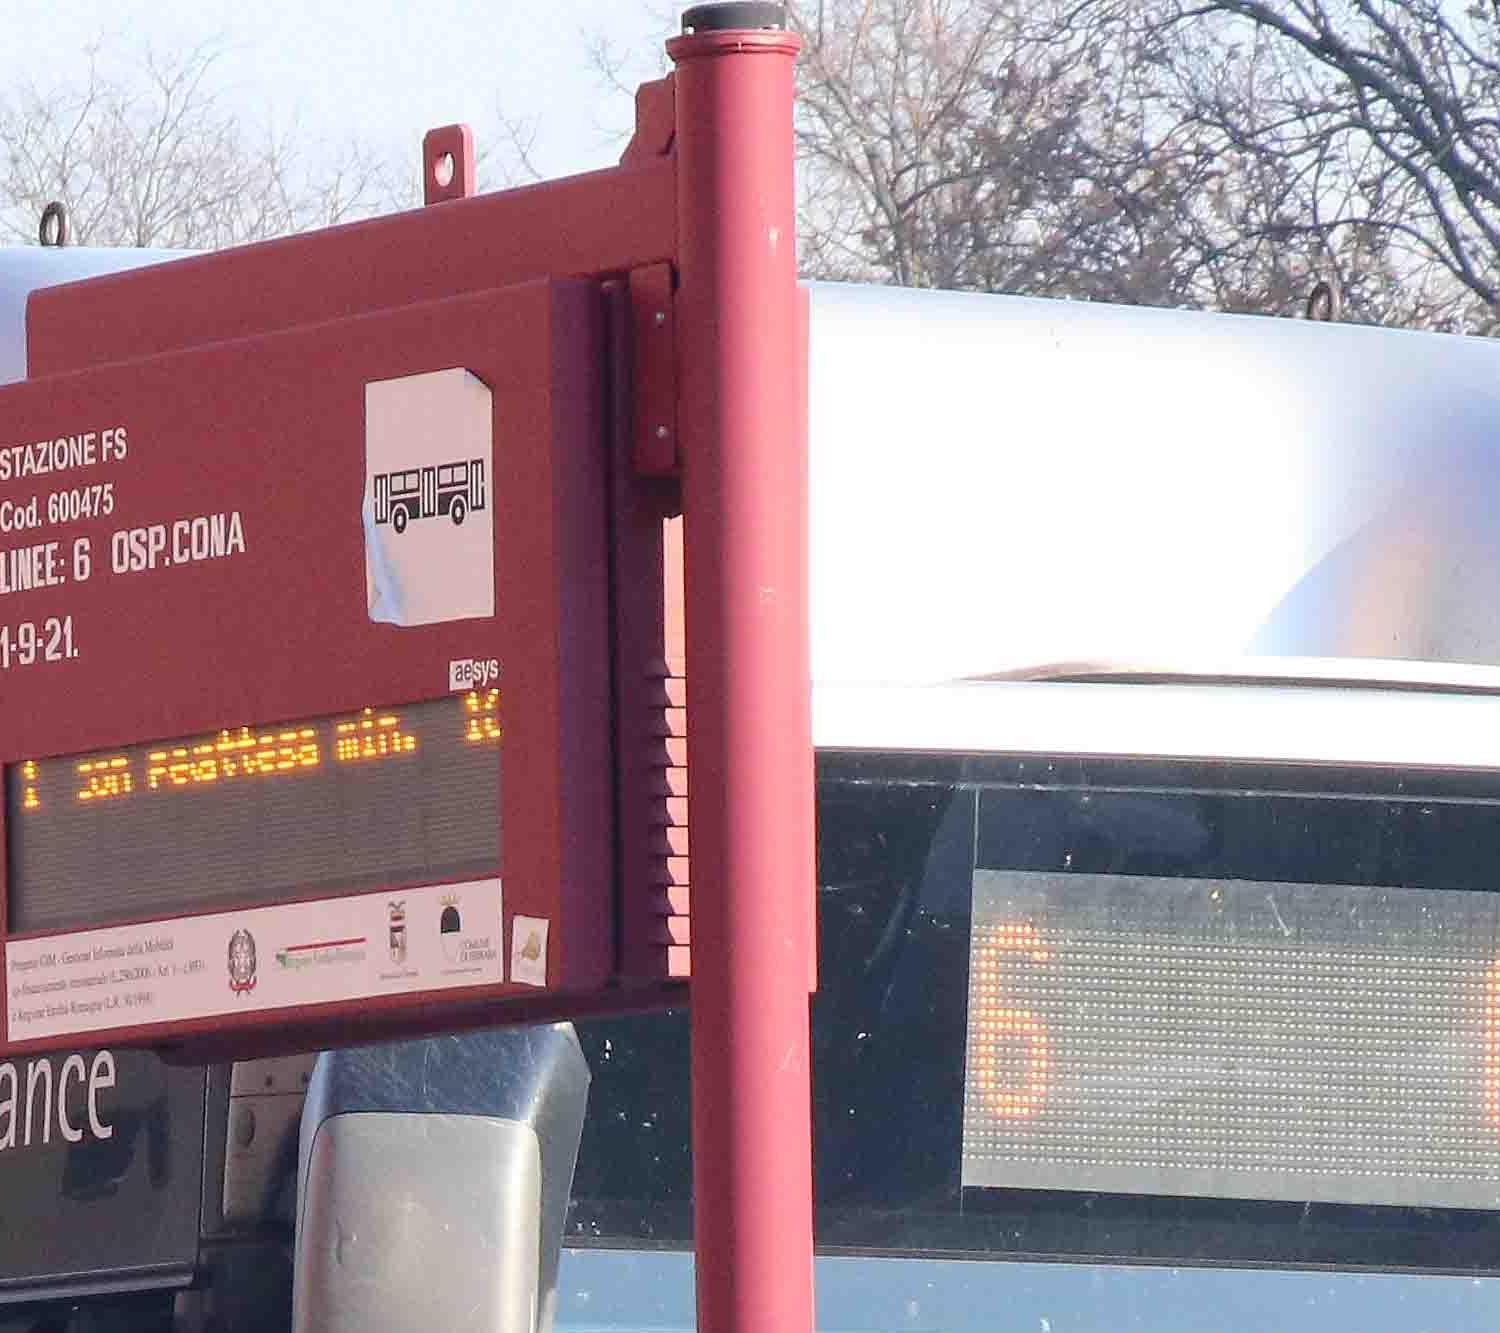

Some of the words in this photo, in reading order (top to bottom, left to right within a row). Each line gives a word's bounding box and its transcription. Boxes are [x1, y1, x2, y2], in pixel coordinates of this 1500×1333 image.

[0, 432, 96, 481] STAZIONE
[101, 427, 128, 463] FS
[0, 495, 43, 532] Cod.
[48, 483, 114, 527] 600475
[0, 541, 67, 594] LINEE:
[72, 537, 91, 582] 6
[111, 511, 245, 575] OSP.CONA
[455, 659, 499, 687] aesys
[977, 921, 1053, 1123] 6
